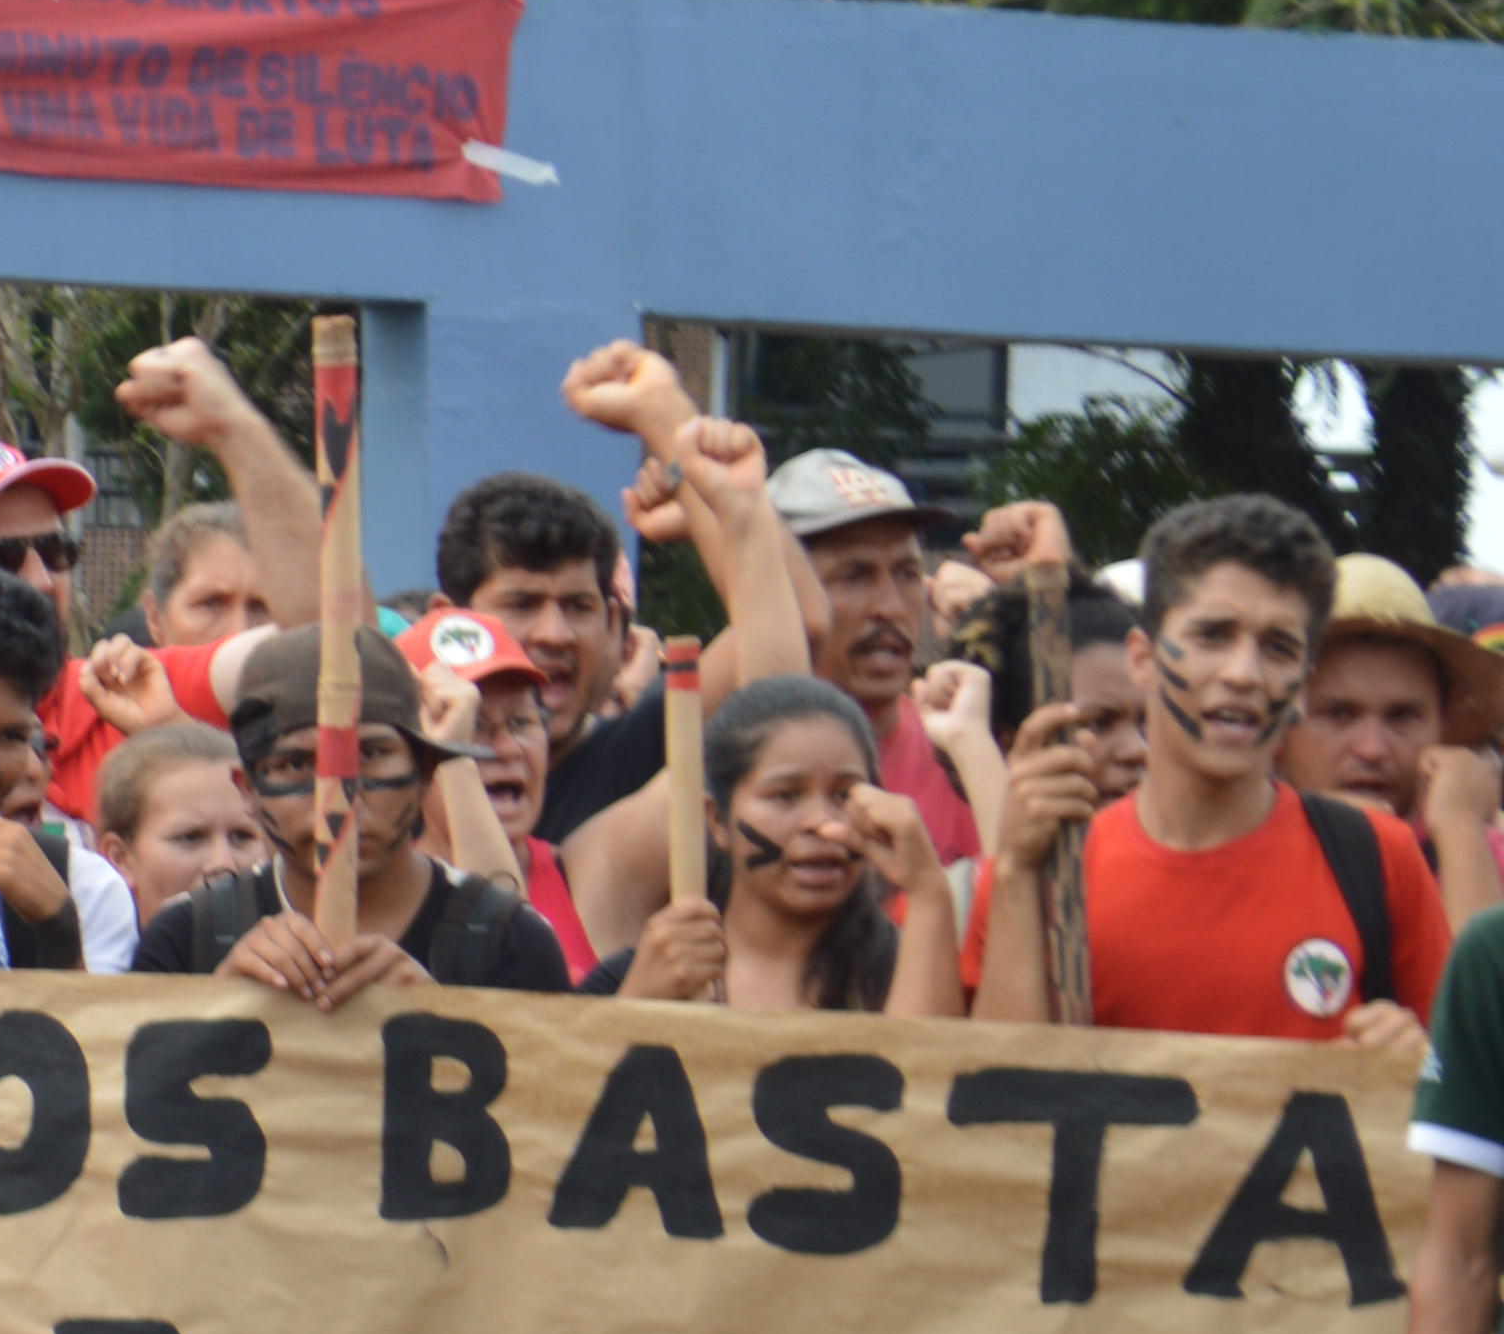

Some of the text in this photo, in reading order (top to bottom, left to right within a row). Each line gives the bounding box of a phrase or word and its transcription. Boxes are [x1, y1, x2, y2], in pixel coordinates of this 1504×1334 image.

[186, 44, 252, 100] DE
[110, 93, 222, 152] VIDA
[234, 105, 296, 160] DE
[312, 111, 437, 173] LUTA
[378, 1011, 1408, 1308] BASTA
